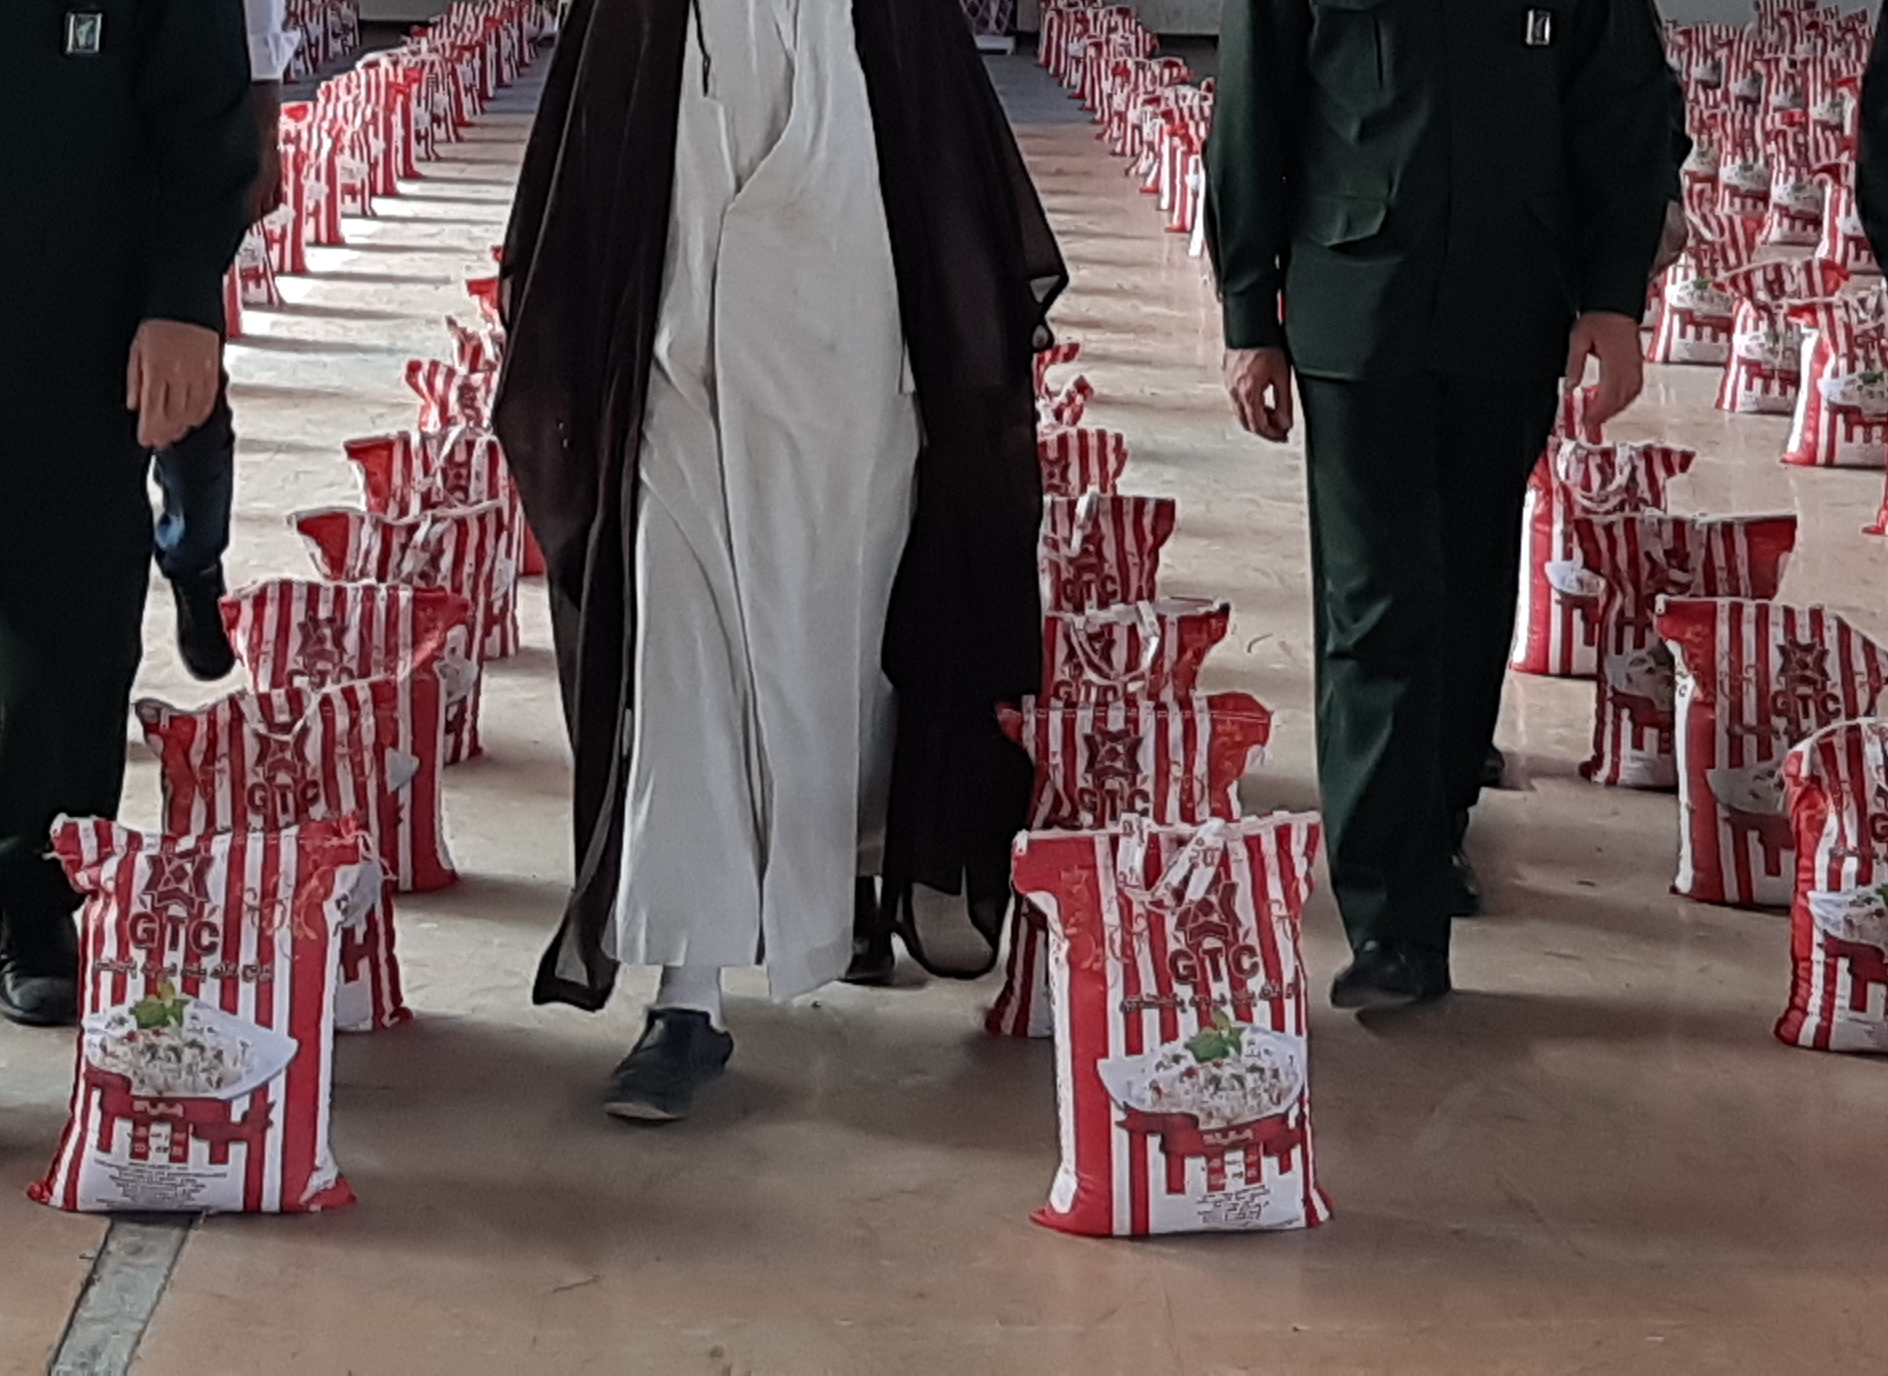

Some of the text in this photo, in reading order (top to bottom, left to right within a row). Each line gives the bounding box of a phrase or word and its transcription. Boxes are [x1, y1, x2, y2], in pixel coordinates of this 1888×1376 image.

[1770, 690, 1843, 721] GTC
[1078, 787, 1152, 821] GTC
[128, 910, 221, 957] GTC
[1168, 944, 1261, 984] GTC
